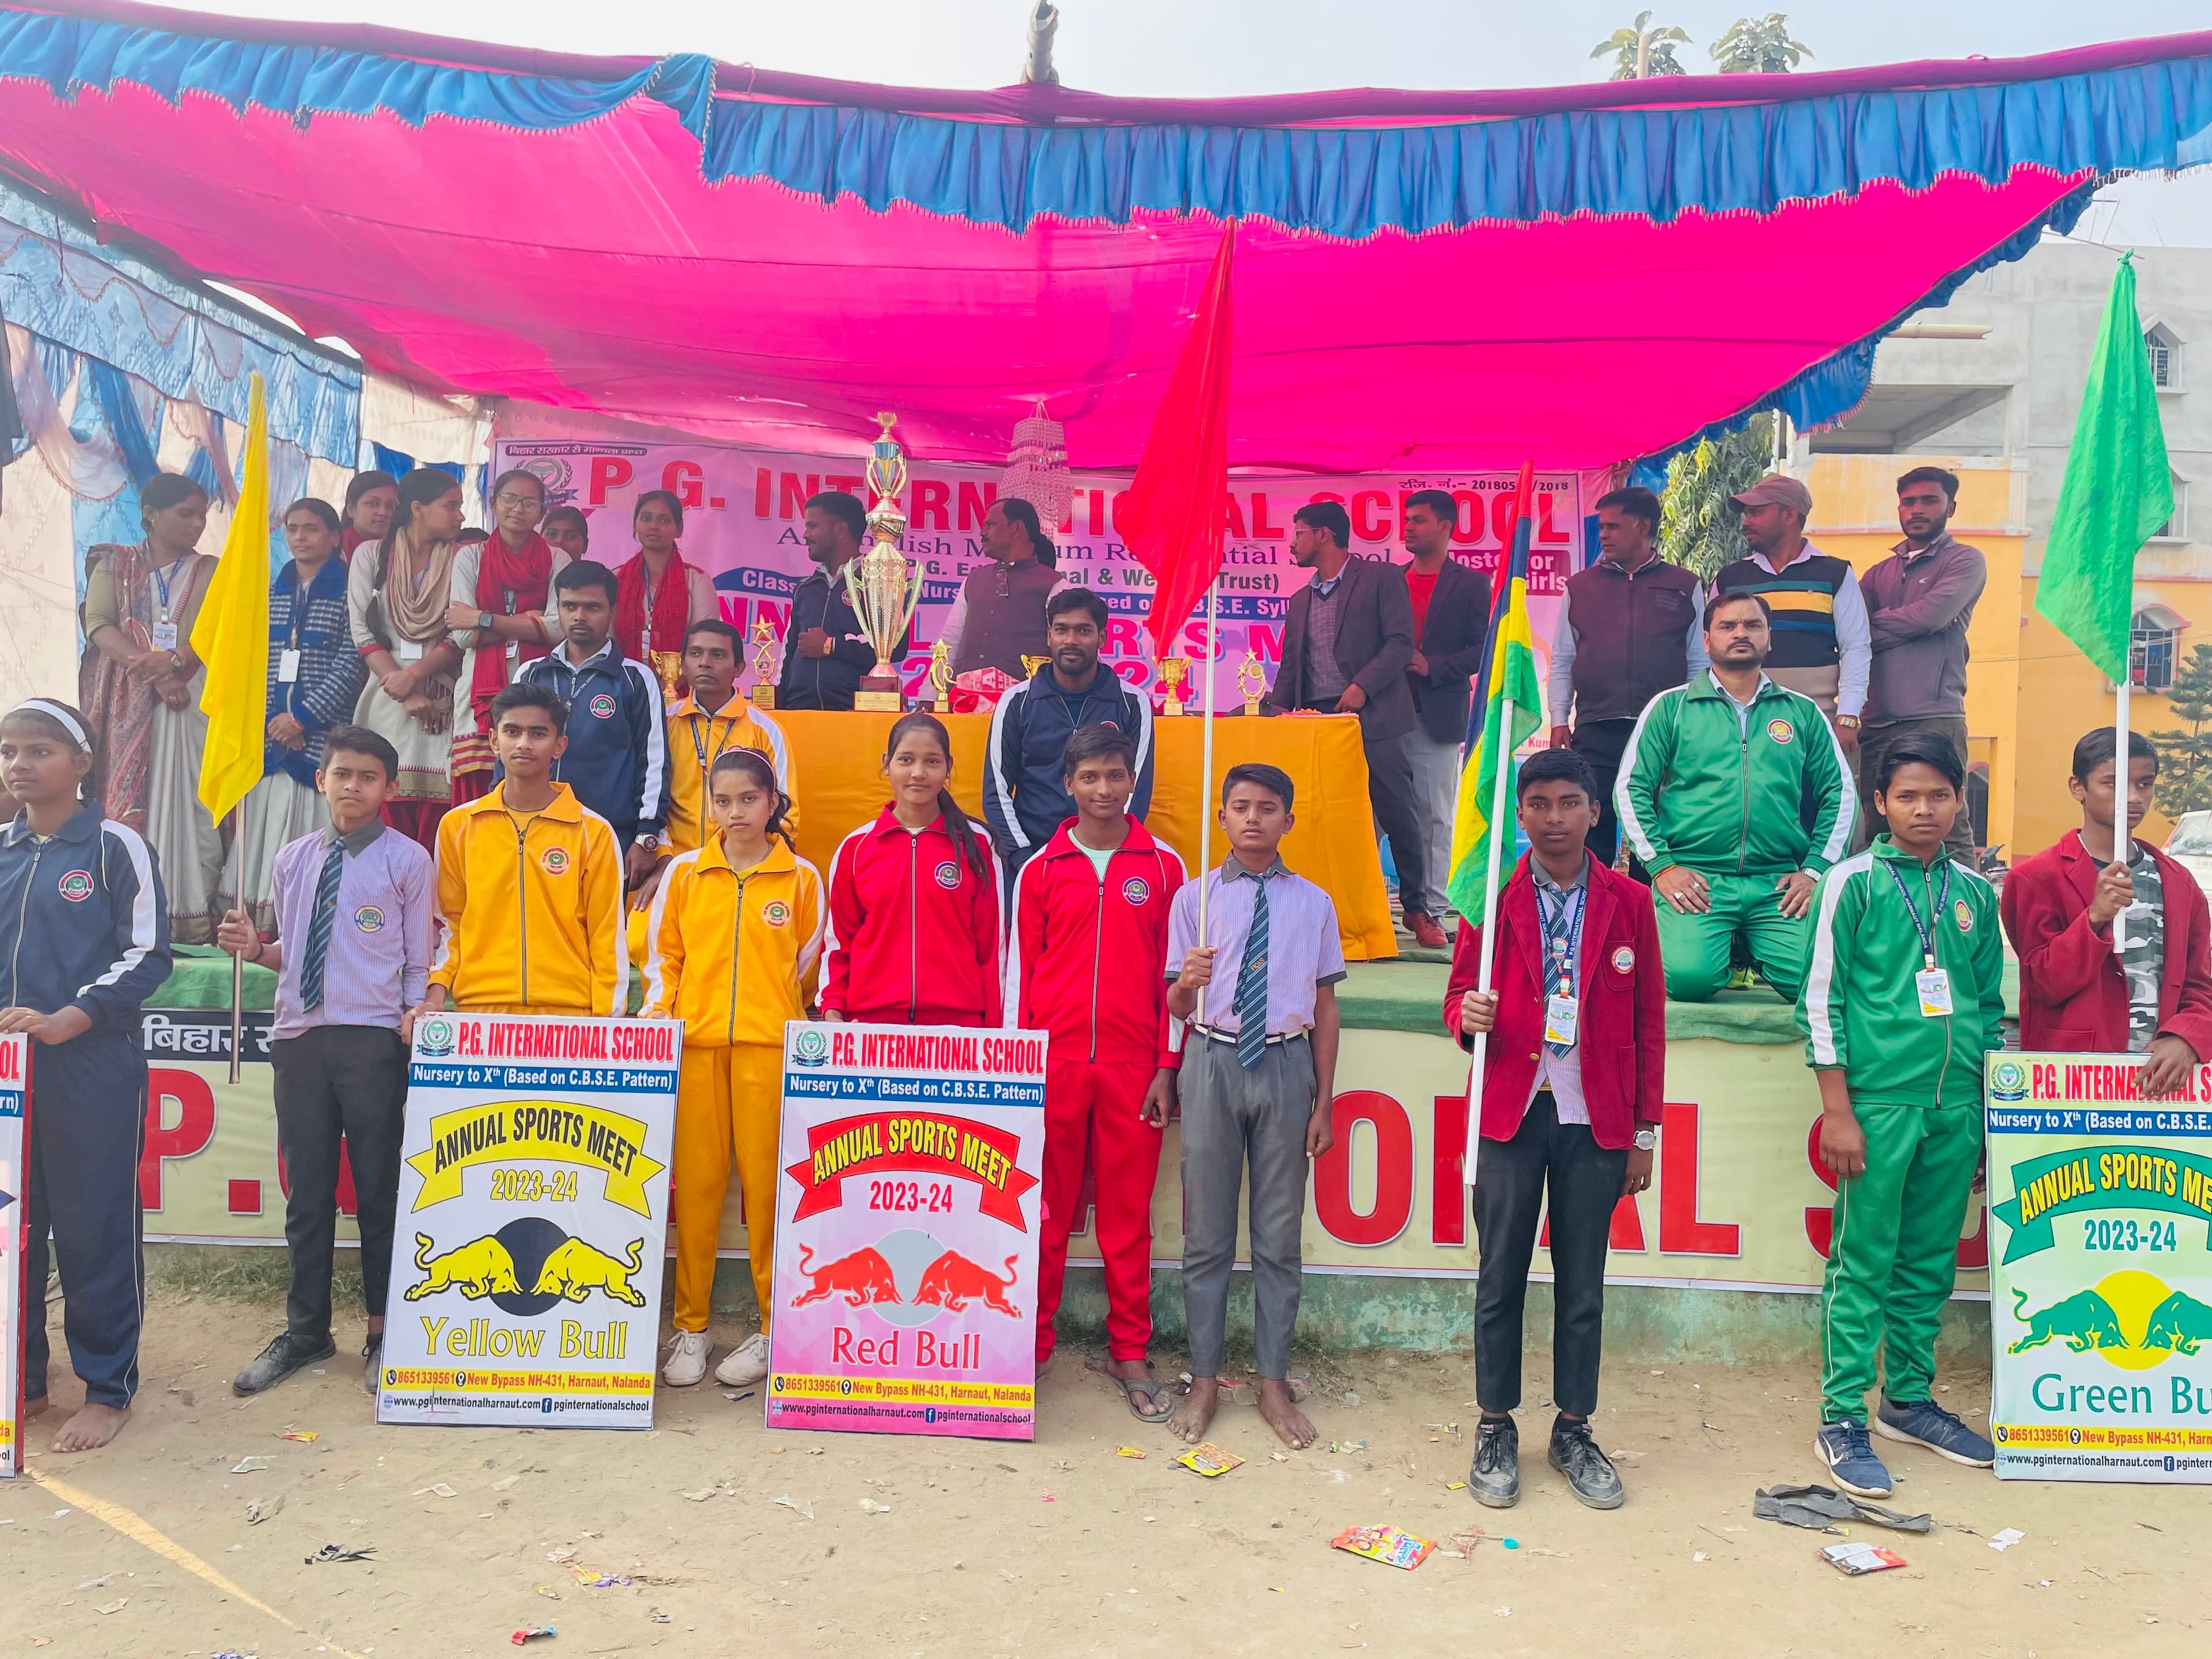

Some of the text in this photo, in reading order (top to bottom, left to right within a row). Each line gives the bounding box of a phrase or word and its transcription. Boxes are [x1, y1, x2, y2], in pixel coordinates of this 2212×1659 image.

[458, 1022, 674, 1063] P.G. INTERNATIONAL SCHOOL
[832, 1032, 1044, 1074] P.G. INTERNATIONAL SCHOOL
[414, 1066, 673, 1092] Nursery to Xth (Based on C.B.S.E. Pattern)
[789, 1075, 1044, 1104] Nursery to Xth (Based on C.B.S.E. Pattern)
[2032, 1063, 2061, 1100] P.G.
[1989, 1111, 2211, 1132] Nursery to Xth (Based on C.B.S.E.
[434, 1107, 638, 1177] ANNUAL SPORTS MEET
[812, 1118, 1012, 1193] ANNUAL SPORTS MEET
[490, 1169, 578, 1202] 2023-24
[869, 1180, 953, 1213] 2023-24
[2019, 1157, 2096, 1226] ANNUAL
[2099, 1152, 2177, 1196] SPORTS
[2084, 1218, 2177, 1252] 2023-24
[420, 1316, 628, 1360] Yellow Bull
[831, 1326, 981, 1370] Red Bull
[397, 1371, 651, 1390] 8651339561 New Bypass NH-431, Harnaut, Nalanda
[785, 1377, 1031, 1402] 8651339561 New Bypass NH-431, Harnaut, Nalanda
[2032, 1373, 2153, 1414] Green
[553, 1400, 650, 1413] pginternationalschool
[782, 1402, 1031, 1424] www.pginternationalharnaut.com pginternationalschool
[2009, 1427, 2069, 1442] 8651339561
[2082, 1431, 2104, 1443] New
[2107, 1431, 2143, 1446] Bypass
[2146, 1431, 2186, 1447] NH-431,
[2007, 1452, 2162, 1469] www.pginternationalharnaut.com
